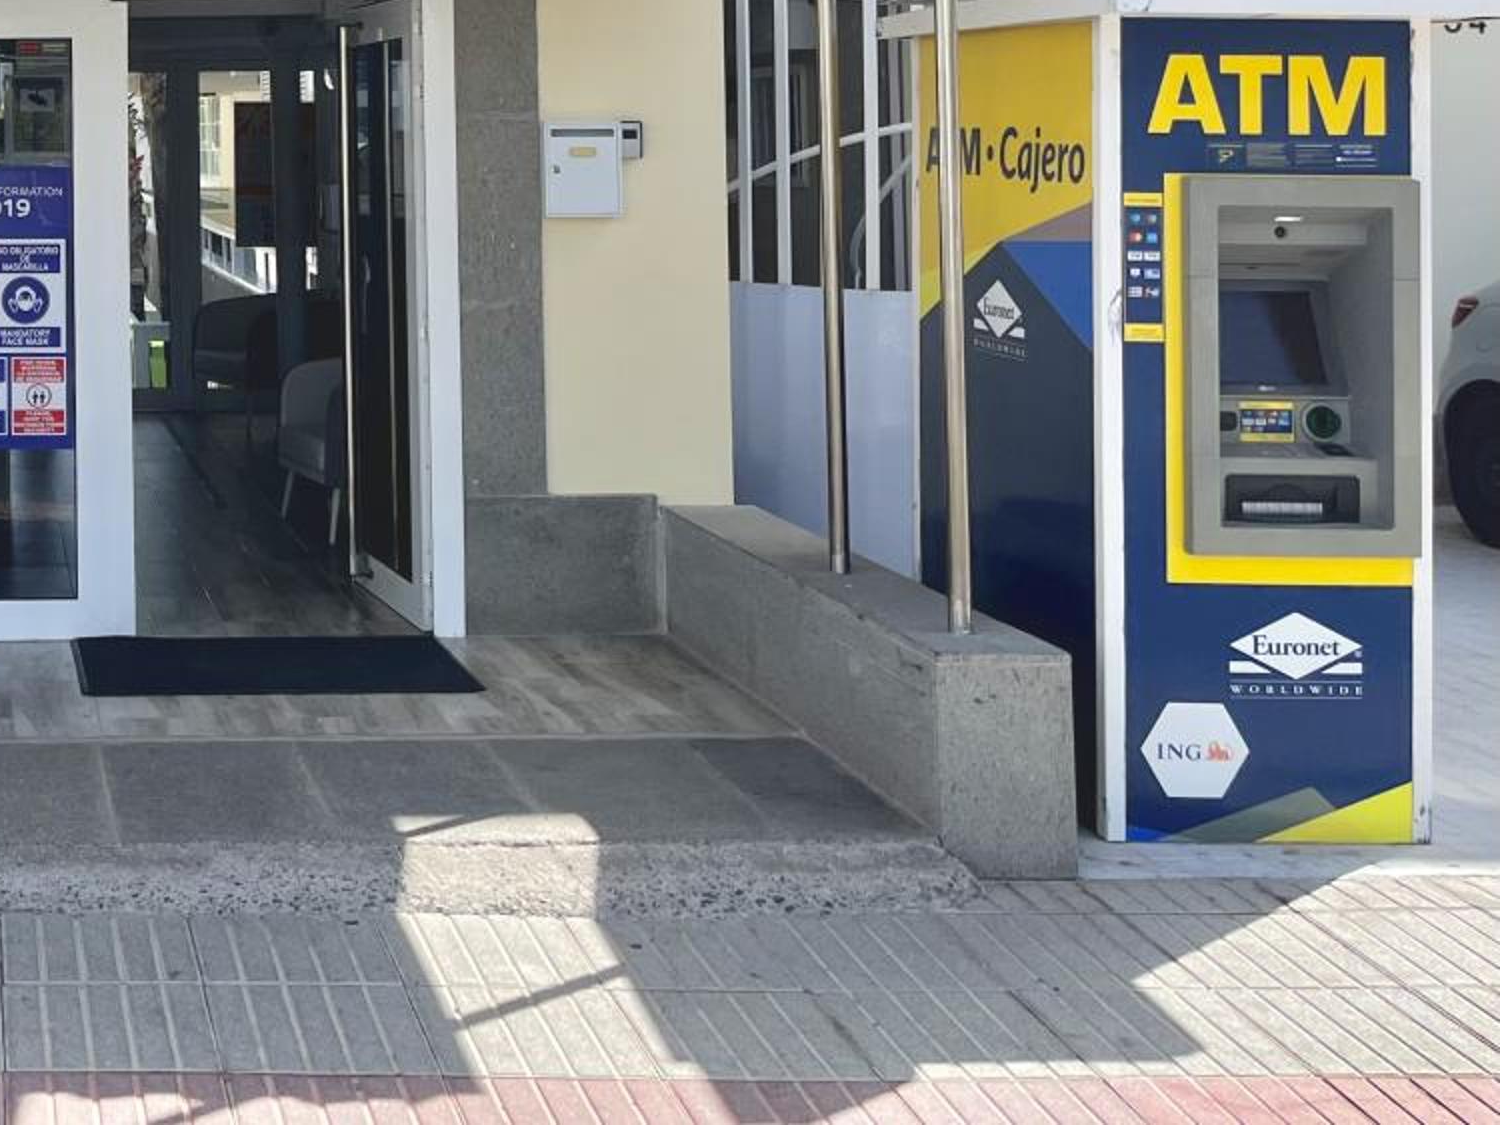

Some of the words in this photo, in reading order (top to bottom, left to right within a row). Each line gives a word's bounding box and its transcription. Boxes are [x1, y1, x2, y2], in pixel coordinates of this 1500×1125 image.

[1148, 53, 1388, 137] ATM
[925, 126, 982, 176] AM
[999, 126, 1086, 194] Cajero
[1251, 634, 1341, 657] Euronet
[1229, 684, 1364, 696] WORLDWIDE
[1156, 742, 1202, 762] ING
